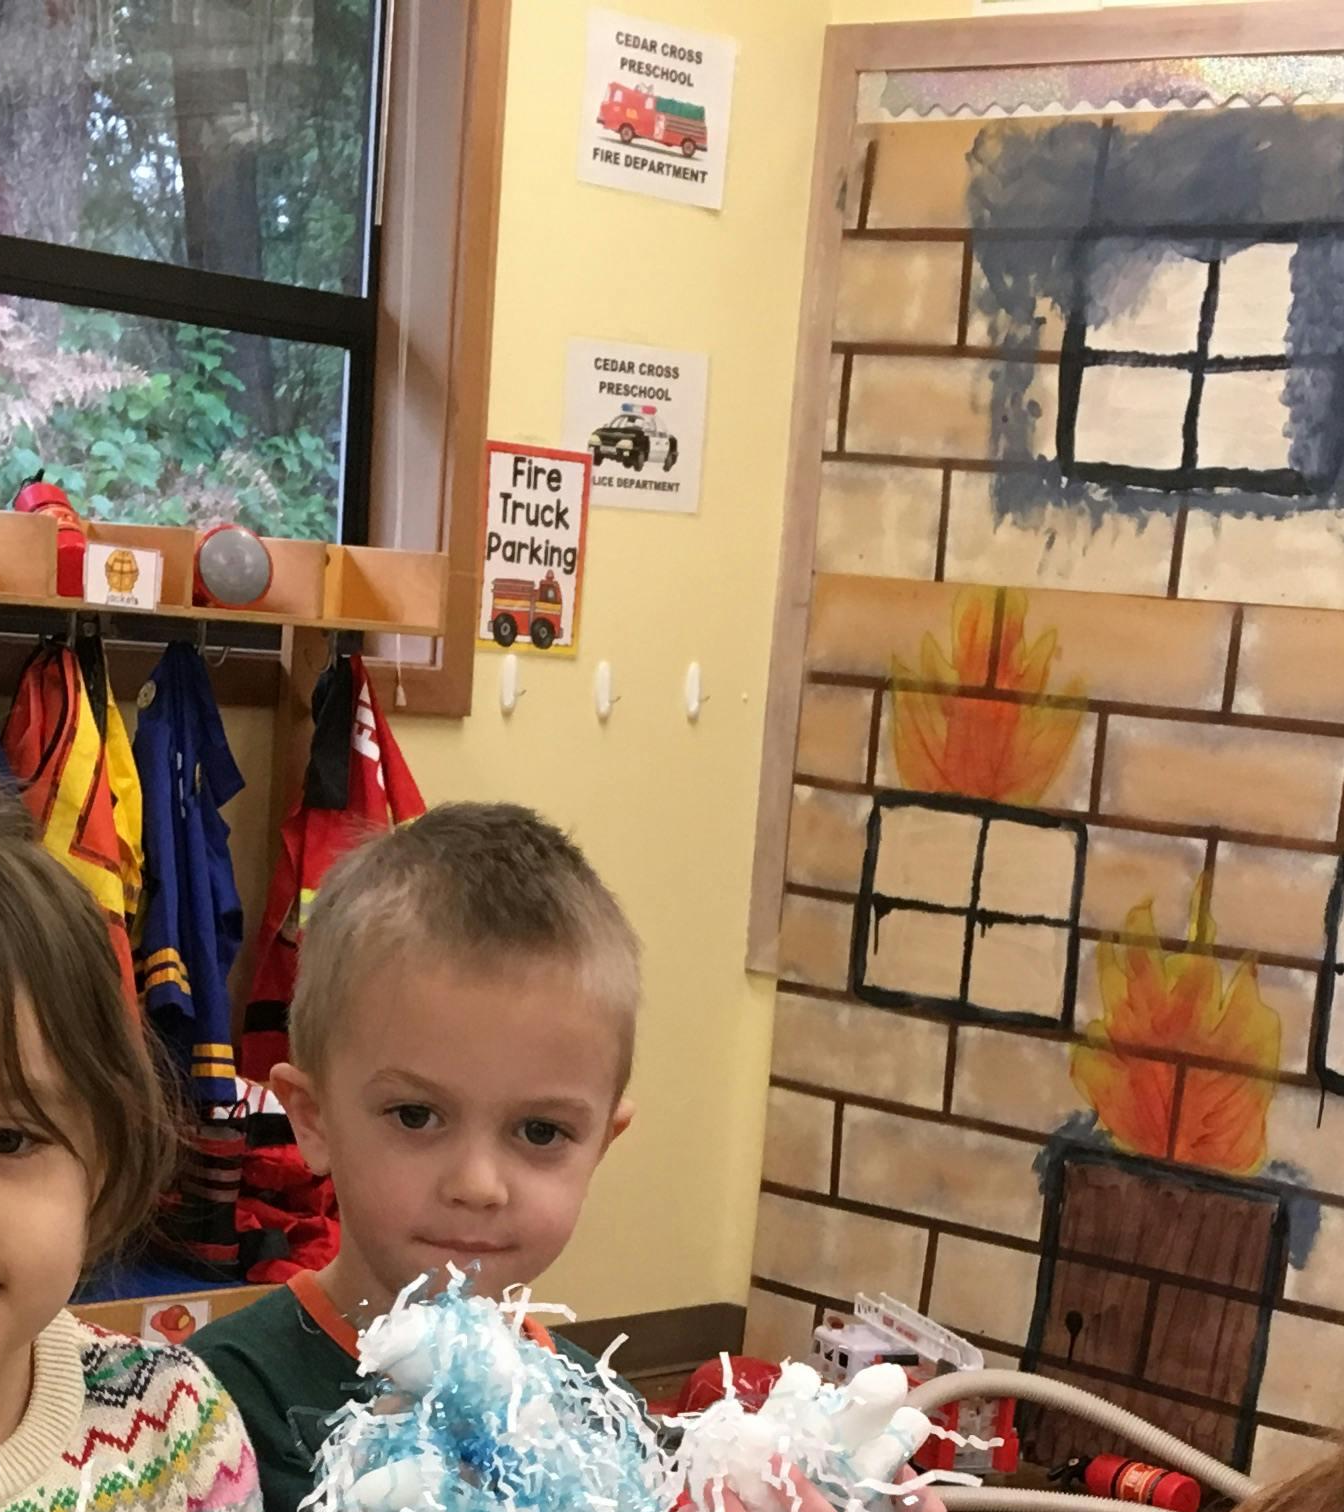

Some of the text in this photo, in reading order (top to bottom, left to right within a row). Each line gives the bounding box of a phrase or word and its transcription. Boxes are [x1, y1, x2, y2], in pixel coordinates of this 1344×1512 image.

[616, 32, 702, 64] CEDAR CROSS
[621, 55, 694, 86] PRESCHOOL
[593, 148, 707, 182] FIRE DEPARTMENT
[595, 358, 679, 379] CEDAR CROSS
[599, 382, 671, 401] PRESCHOOL
[513, 455, 566, 491] Fire
[617, 478, 680, 492] DEPARTMENT
[500, 493, 569, 529] Truck
[487, 532, 579, 578] Parking
